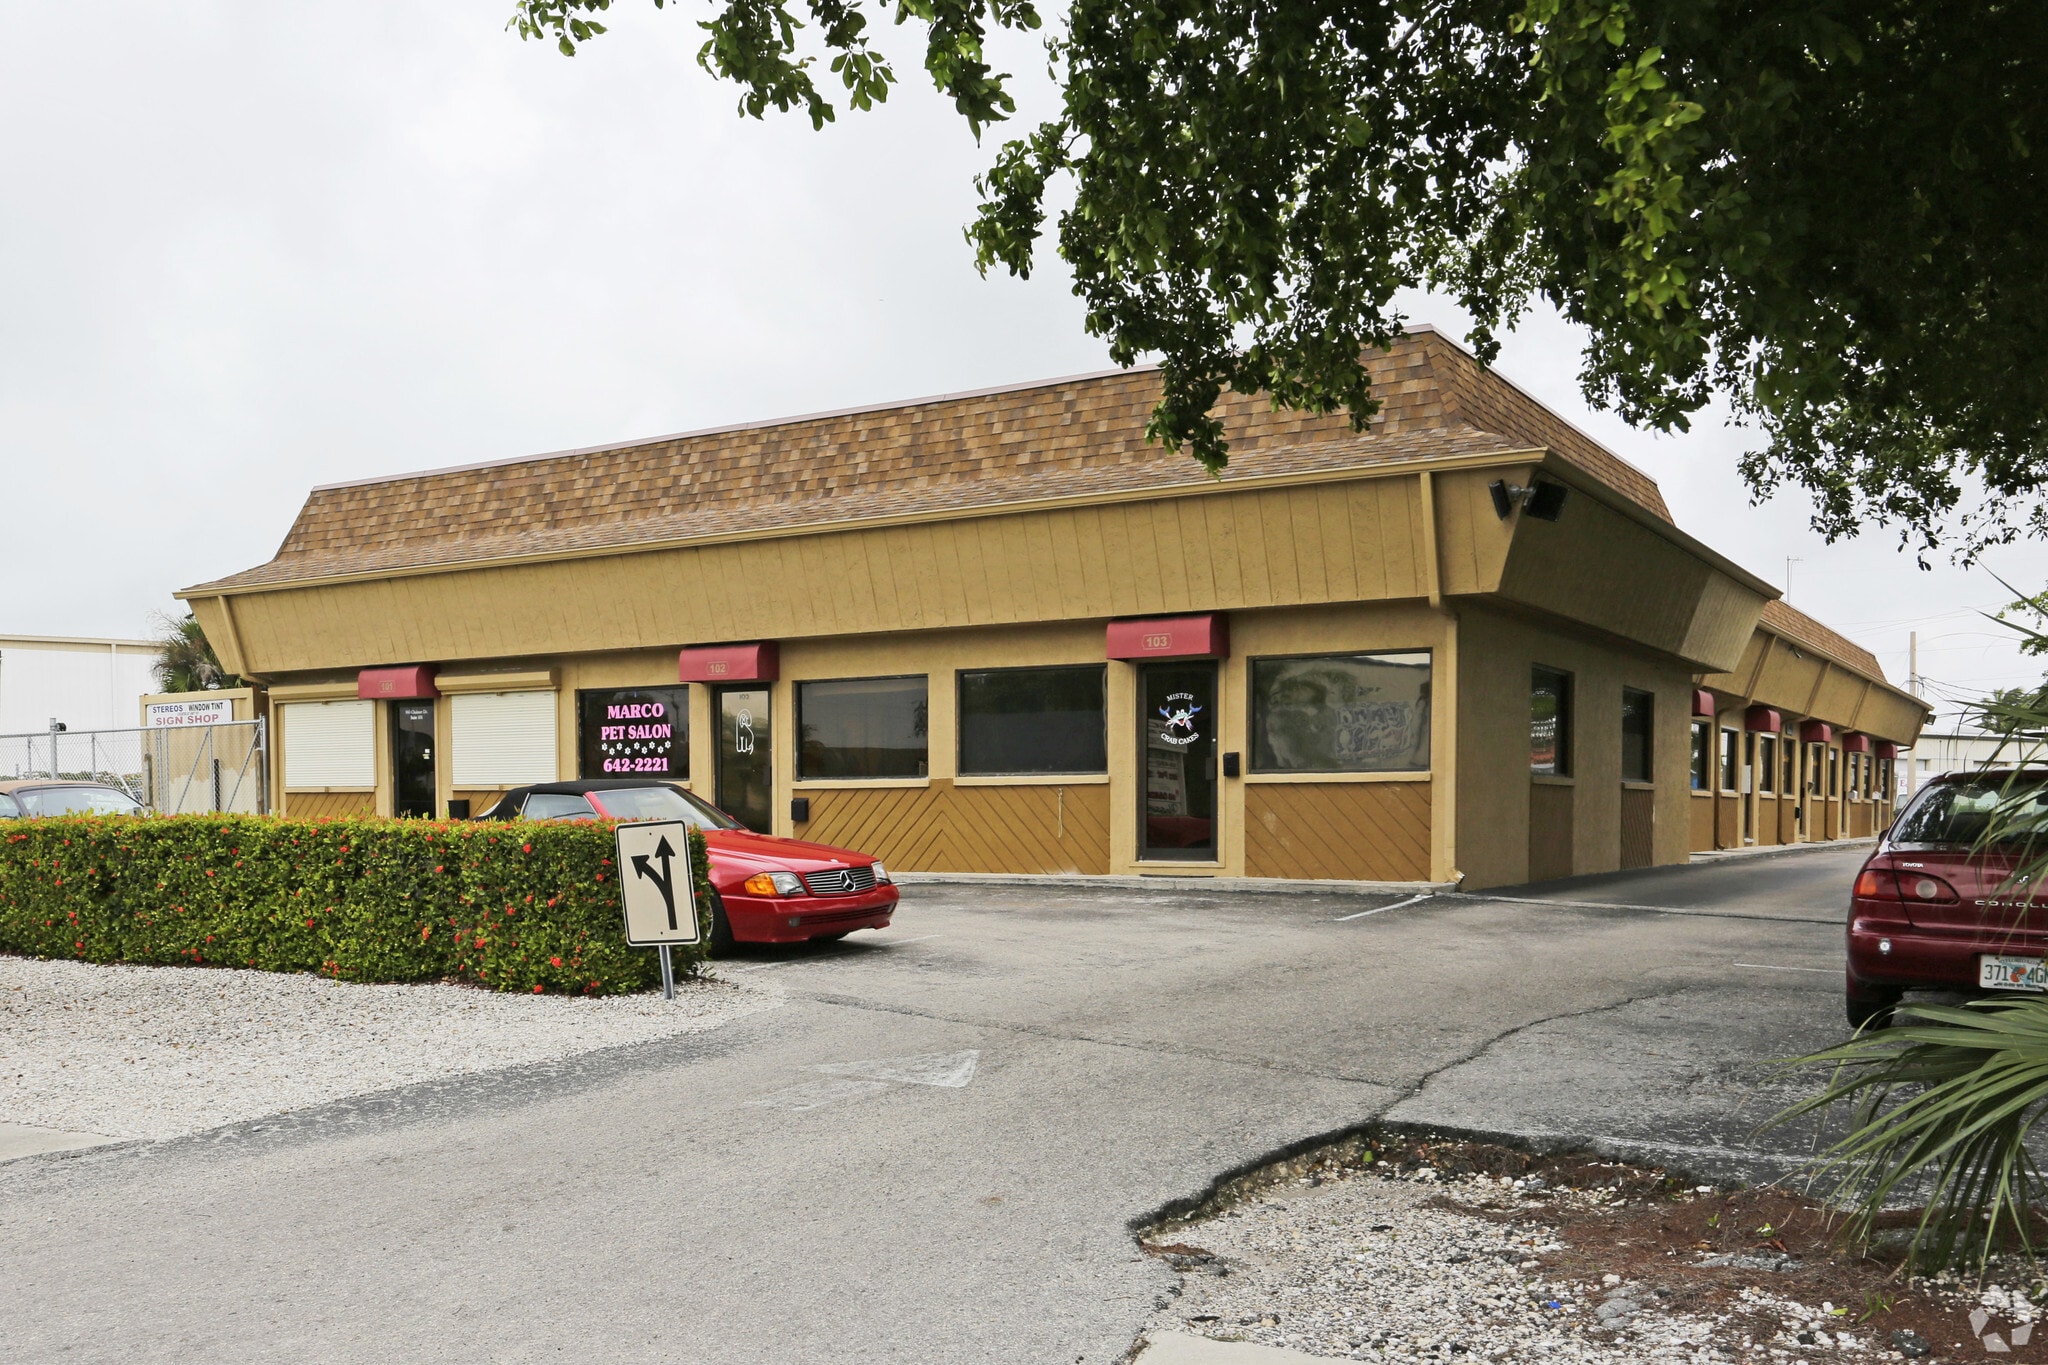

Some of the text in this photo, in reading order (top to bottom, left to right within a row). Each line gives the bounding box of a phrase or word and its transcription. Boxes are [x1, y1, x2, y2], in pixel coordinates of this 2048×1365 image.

[1146, 636, 1168, 647] 103
[709, 664, 726, 673] 102
[382, 682, 393, 691] 101
[1166, 692, 1194, 701] MISTER
[152, 702, 223, 713] STEREOS WINDOW TINT
[607, 703, 664, 719] MARCO
[156, 714, 219, 726] SIGN SHOP
[601, 723, 671, 740] PET SALON
[1160, 732, 1200, 745] CRAB CAKES
[603, 757, 668, 773] 642-2221
[1984, 964, 2009, 981] 371
